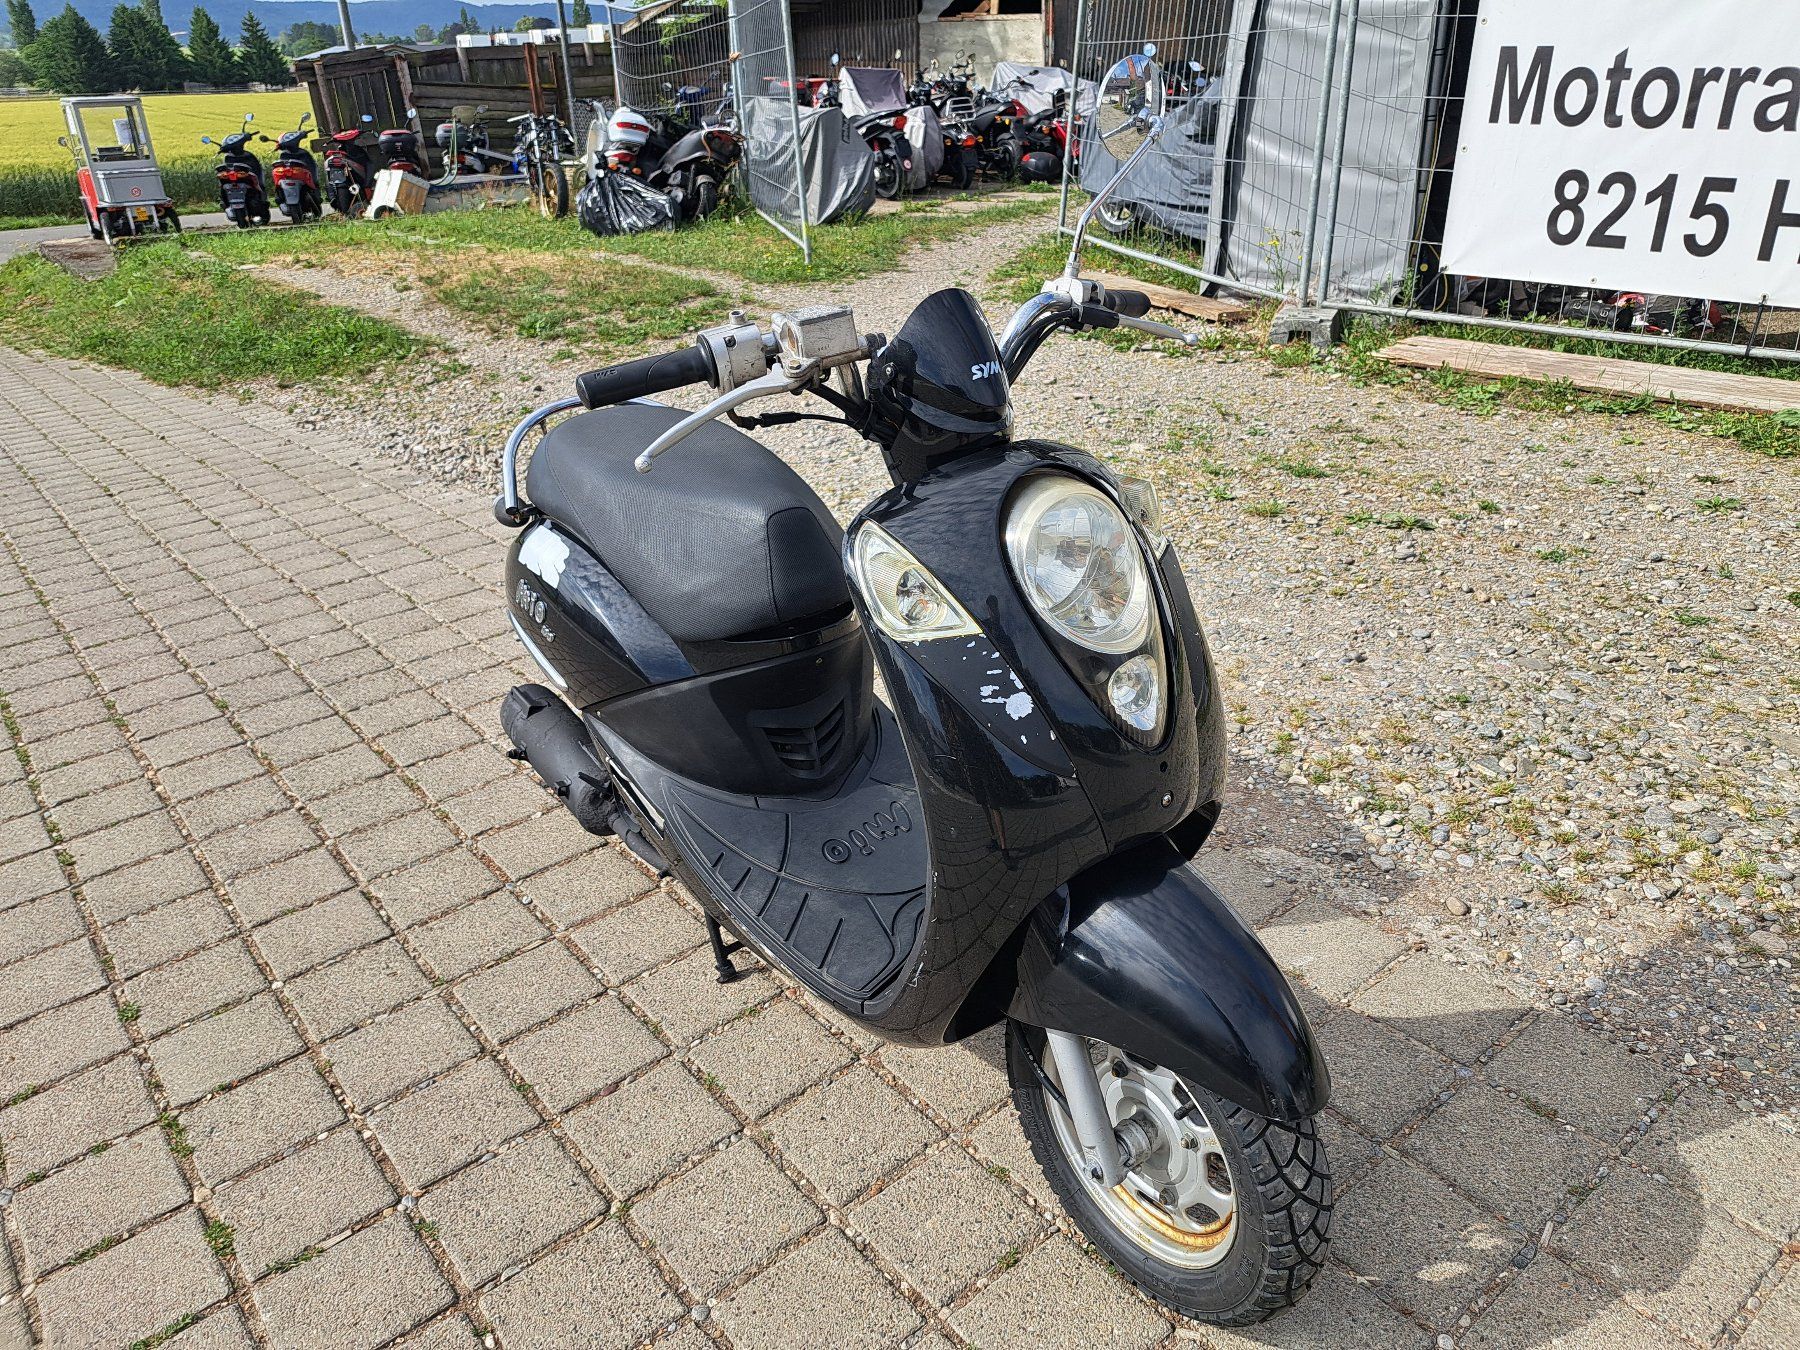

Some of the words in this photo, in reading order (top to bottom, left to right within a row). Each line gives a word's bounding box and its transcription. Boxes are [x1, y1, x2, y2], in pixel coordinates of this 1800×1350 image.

[1488, 45, 1800, 133] Motorra
[1546, 168, 1738, 258] 8215
[971, 360, 1001, 380] SYM
